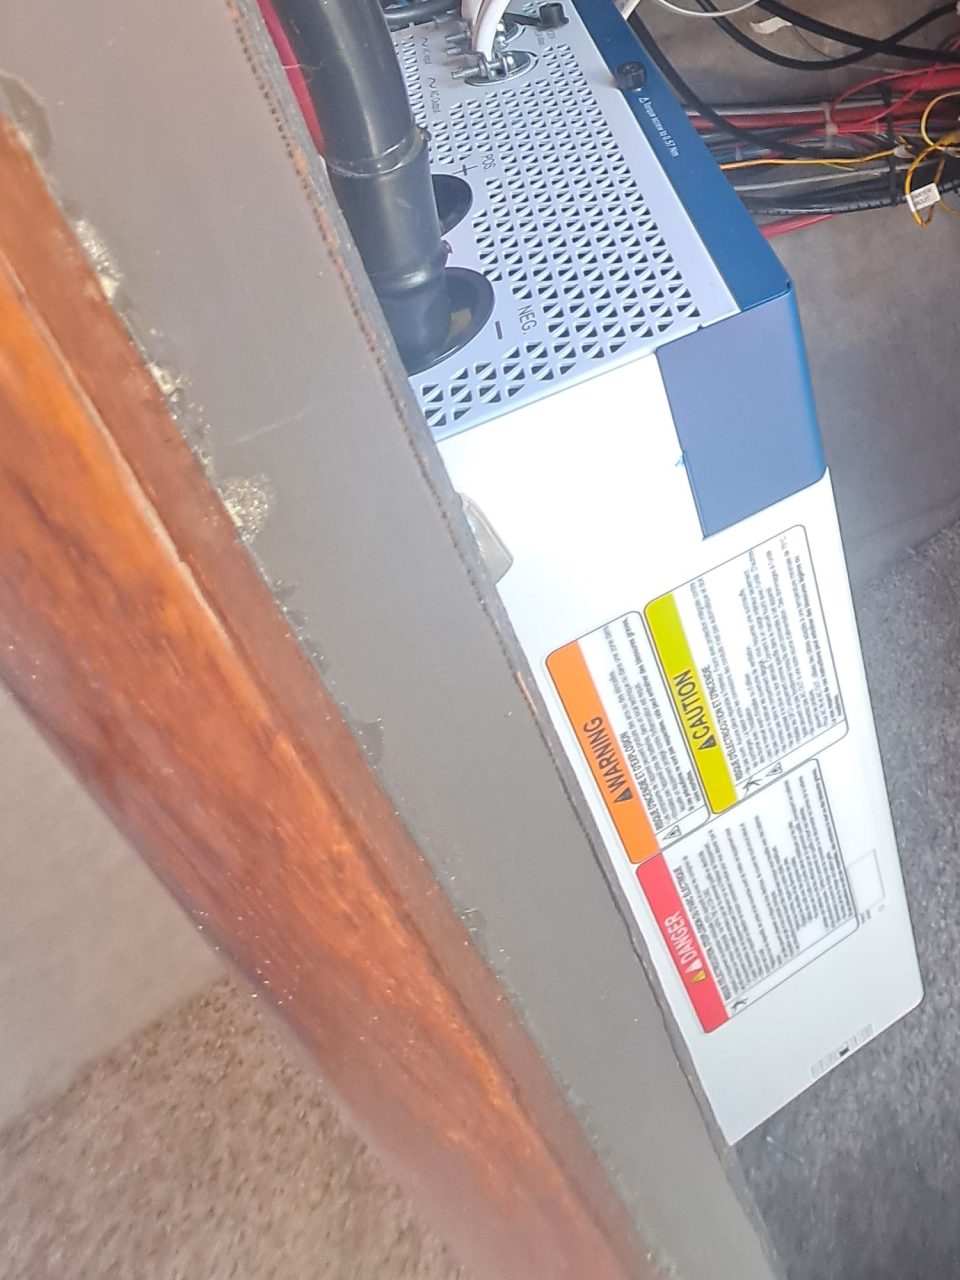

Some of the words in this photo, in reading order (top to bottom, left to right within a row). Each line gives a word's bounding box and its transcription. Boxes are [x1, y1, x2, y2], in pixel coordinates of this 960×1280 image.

[517, 304, 537, 335] NEG.
[672, 667, 712, 742] CAUTION
[580, 713, 628, 793] WARNING
[662, 909, 698, 965] DANGER
